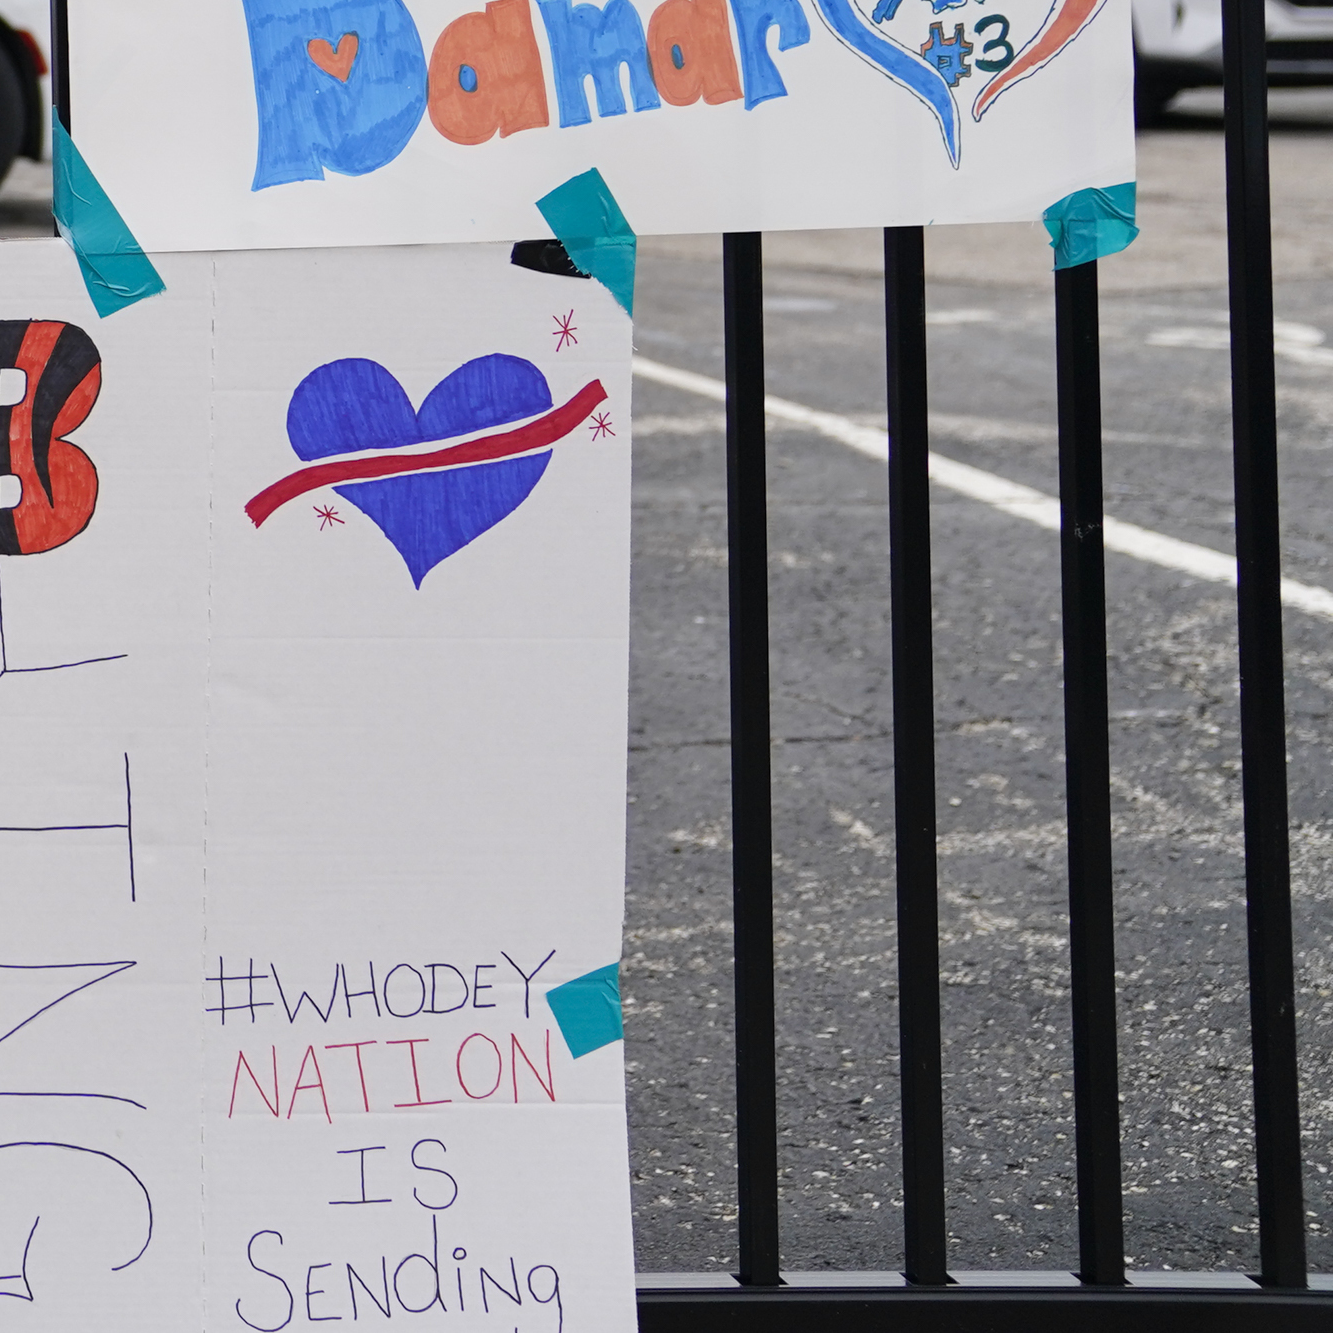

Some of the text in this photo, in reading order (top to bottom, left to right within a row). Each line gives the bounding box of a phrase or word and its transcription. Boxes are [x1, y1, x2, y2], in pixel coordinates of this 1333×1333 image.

[919, 13, 1015, 88] #3
[205, 949, 556, 1025] #WHODEY
[228, 1029, 555, 1124] NATION
[329, 1139, 458, 1210] IS
